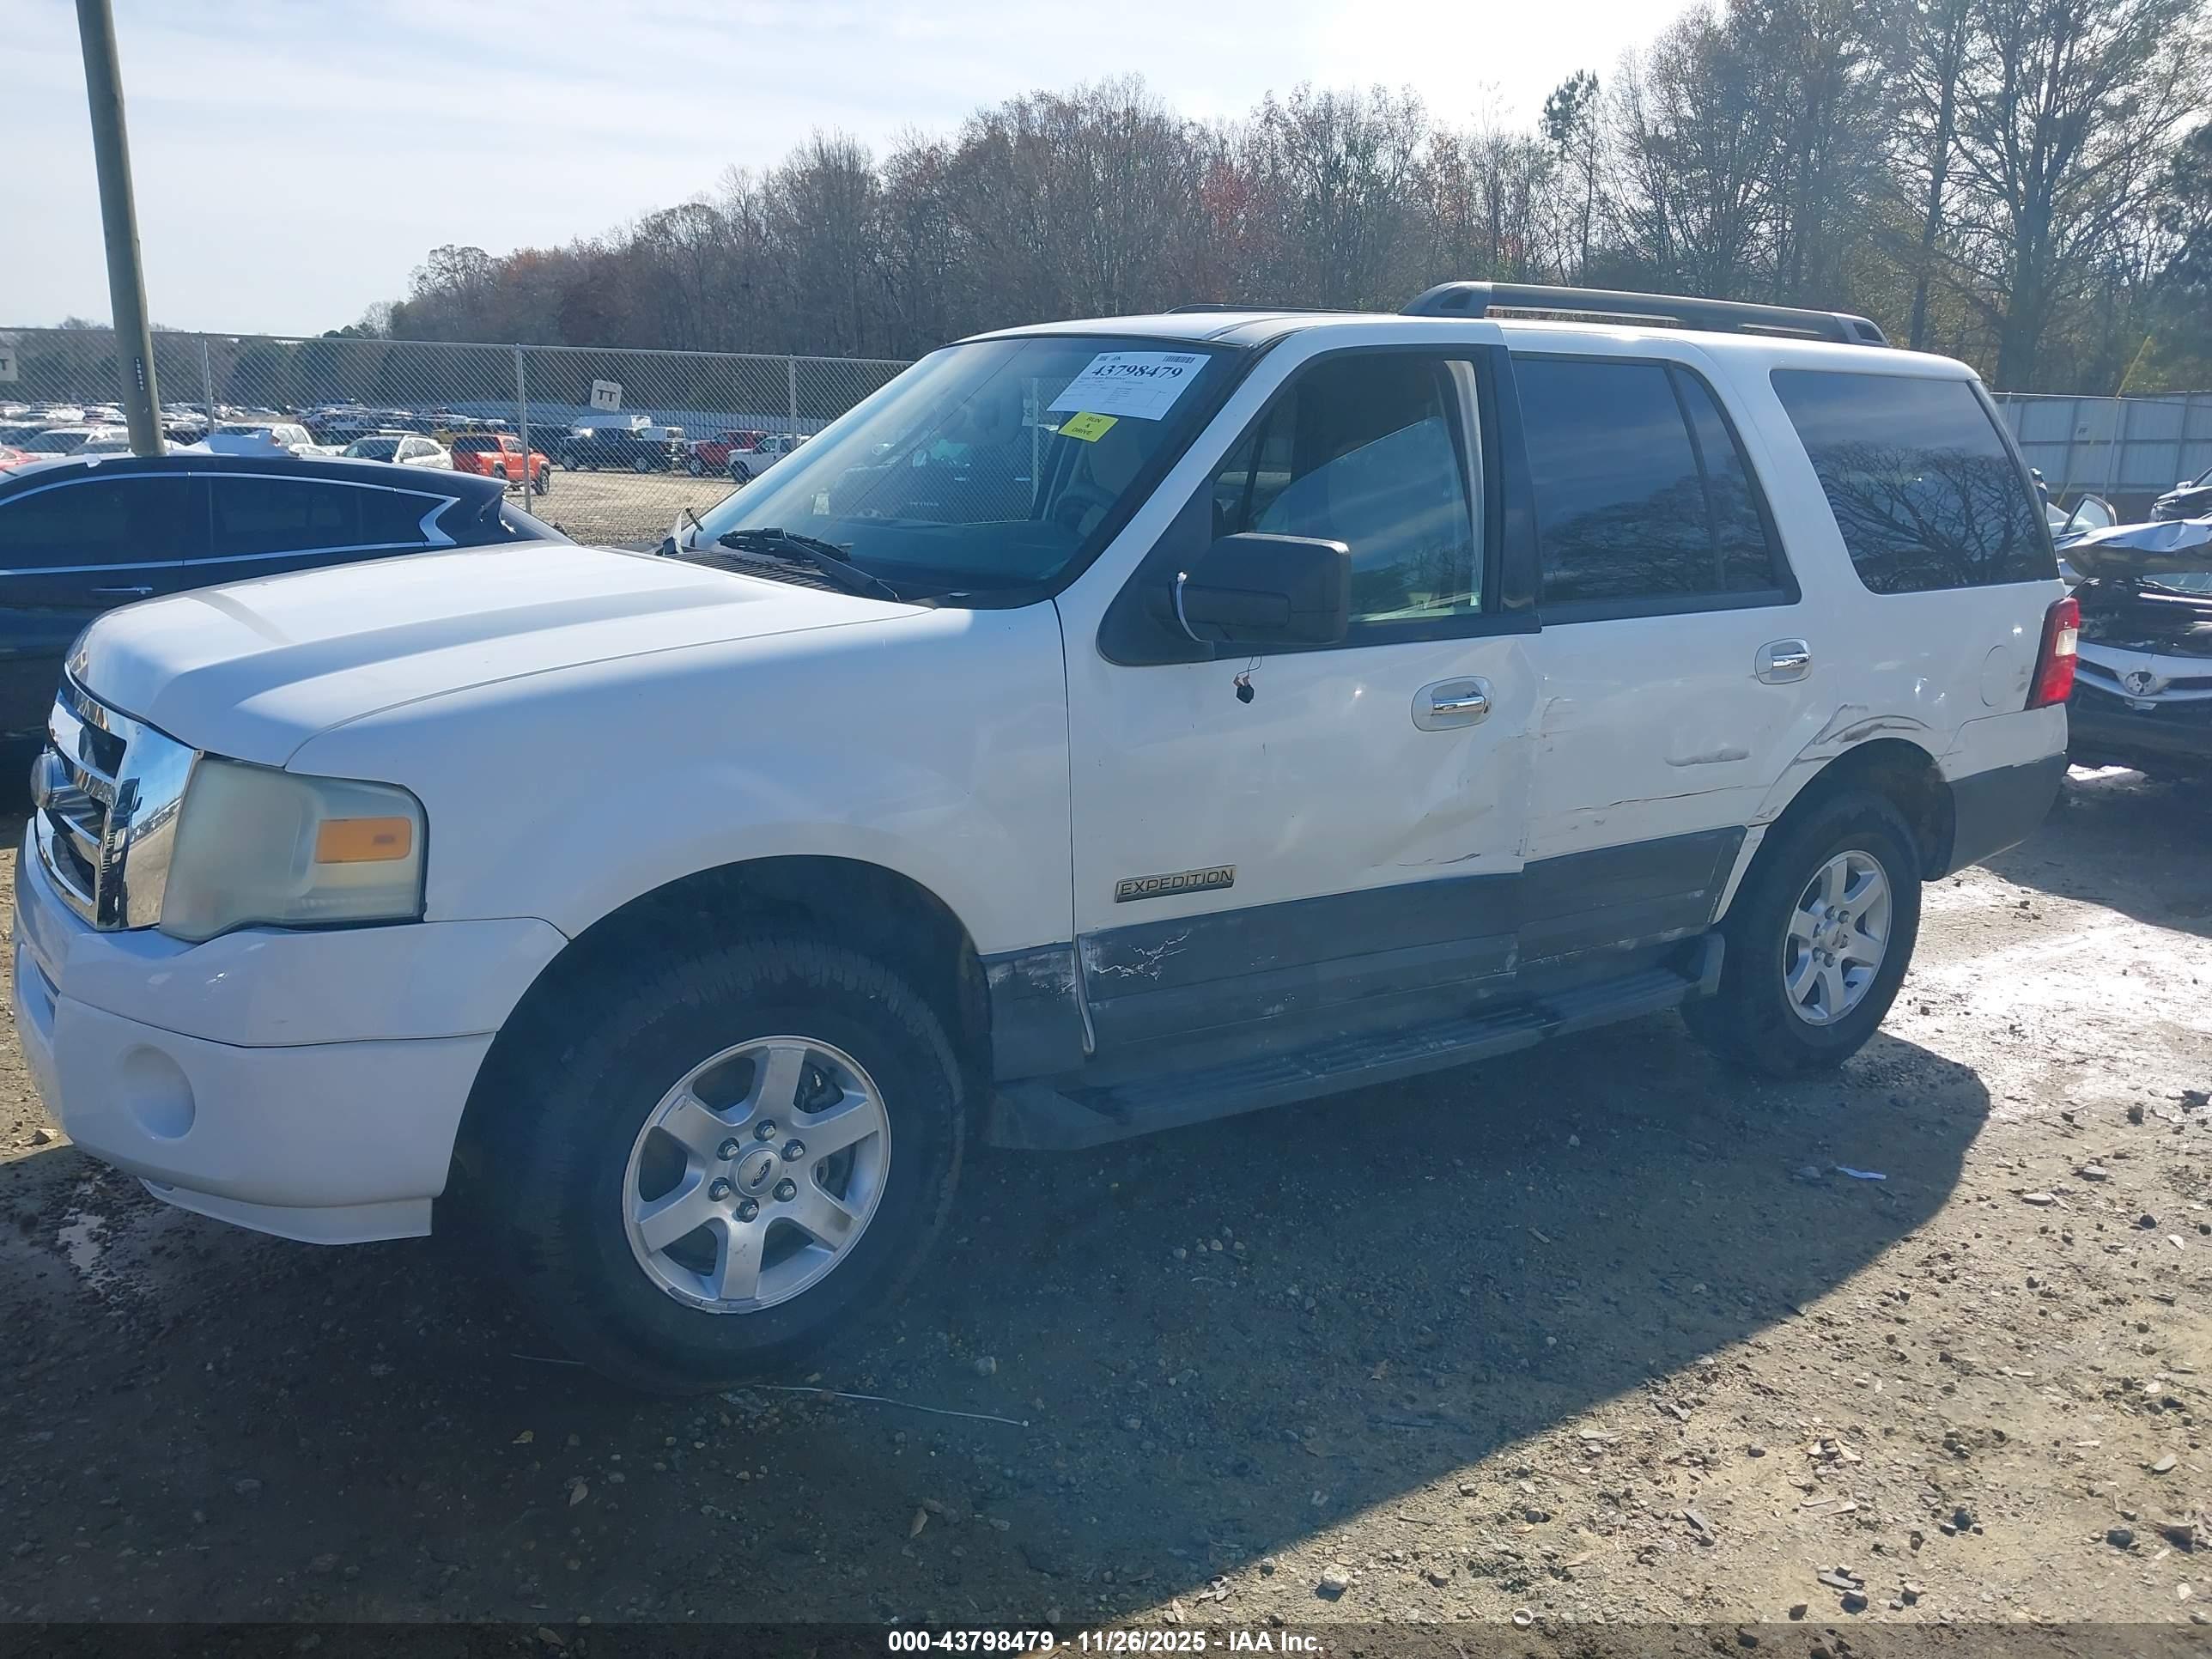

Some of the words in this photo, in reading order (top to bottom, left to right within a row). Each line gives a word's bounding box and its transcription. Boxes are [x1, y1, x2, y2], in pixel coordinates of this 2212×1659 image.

[1091, 365, 1183, 380] 43798479
[598, 389, 617, 403] TT
[1072, 427, 1093, 436] DRIVE
[1120, 868, 1235, 895] EXPEDITION
